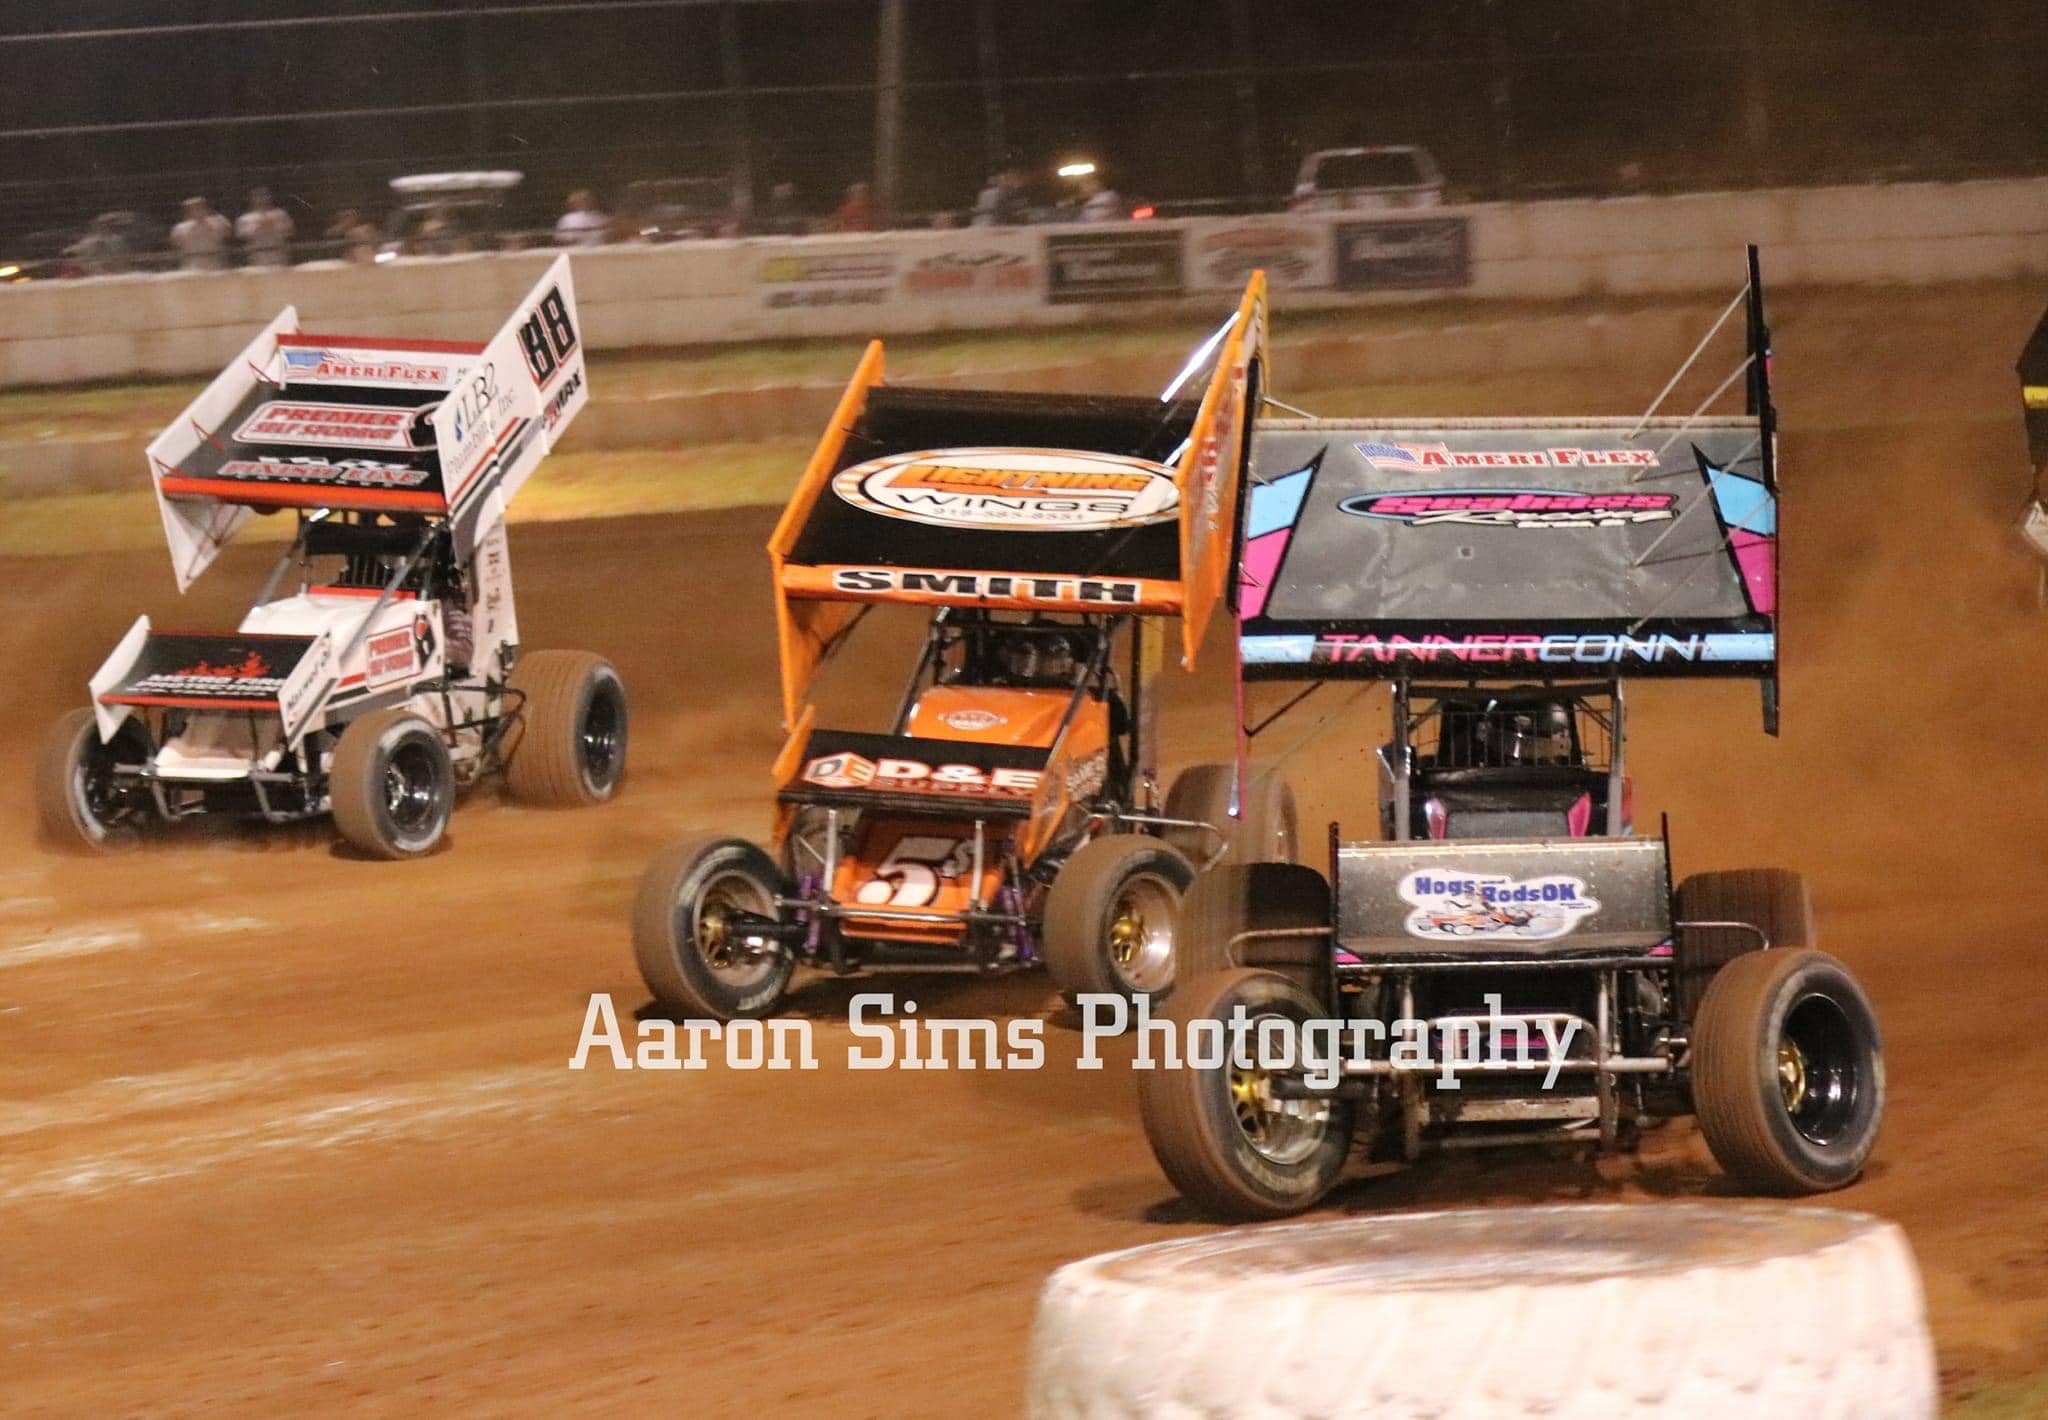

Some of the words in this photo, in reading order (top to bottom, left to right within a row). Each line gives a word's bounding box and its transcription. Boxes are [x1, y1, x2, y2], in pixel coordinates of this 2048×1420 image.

[517, 284, 578, 388] 88
[267, 407, 405, 426] PREMIER
[897, 493, 1129, 514] WINGS
[833, 570, 1142, 603] SMITH
[1415, 877, 1476, 897] Hogs
